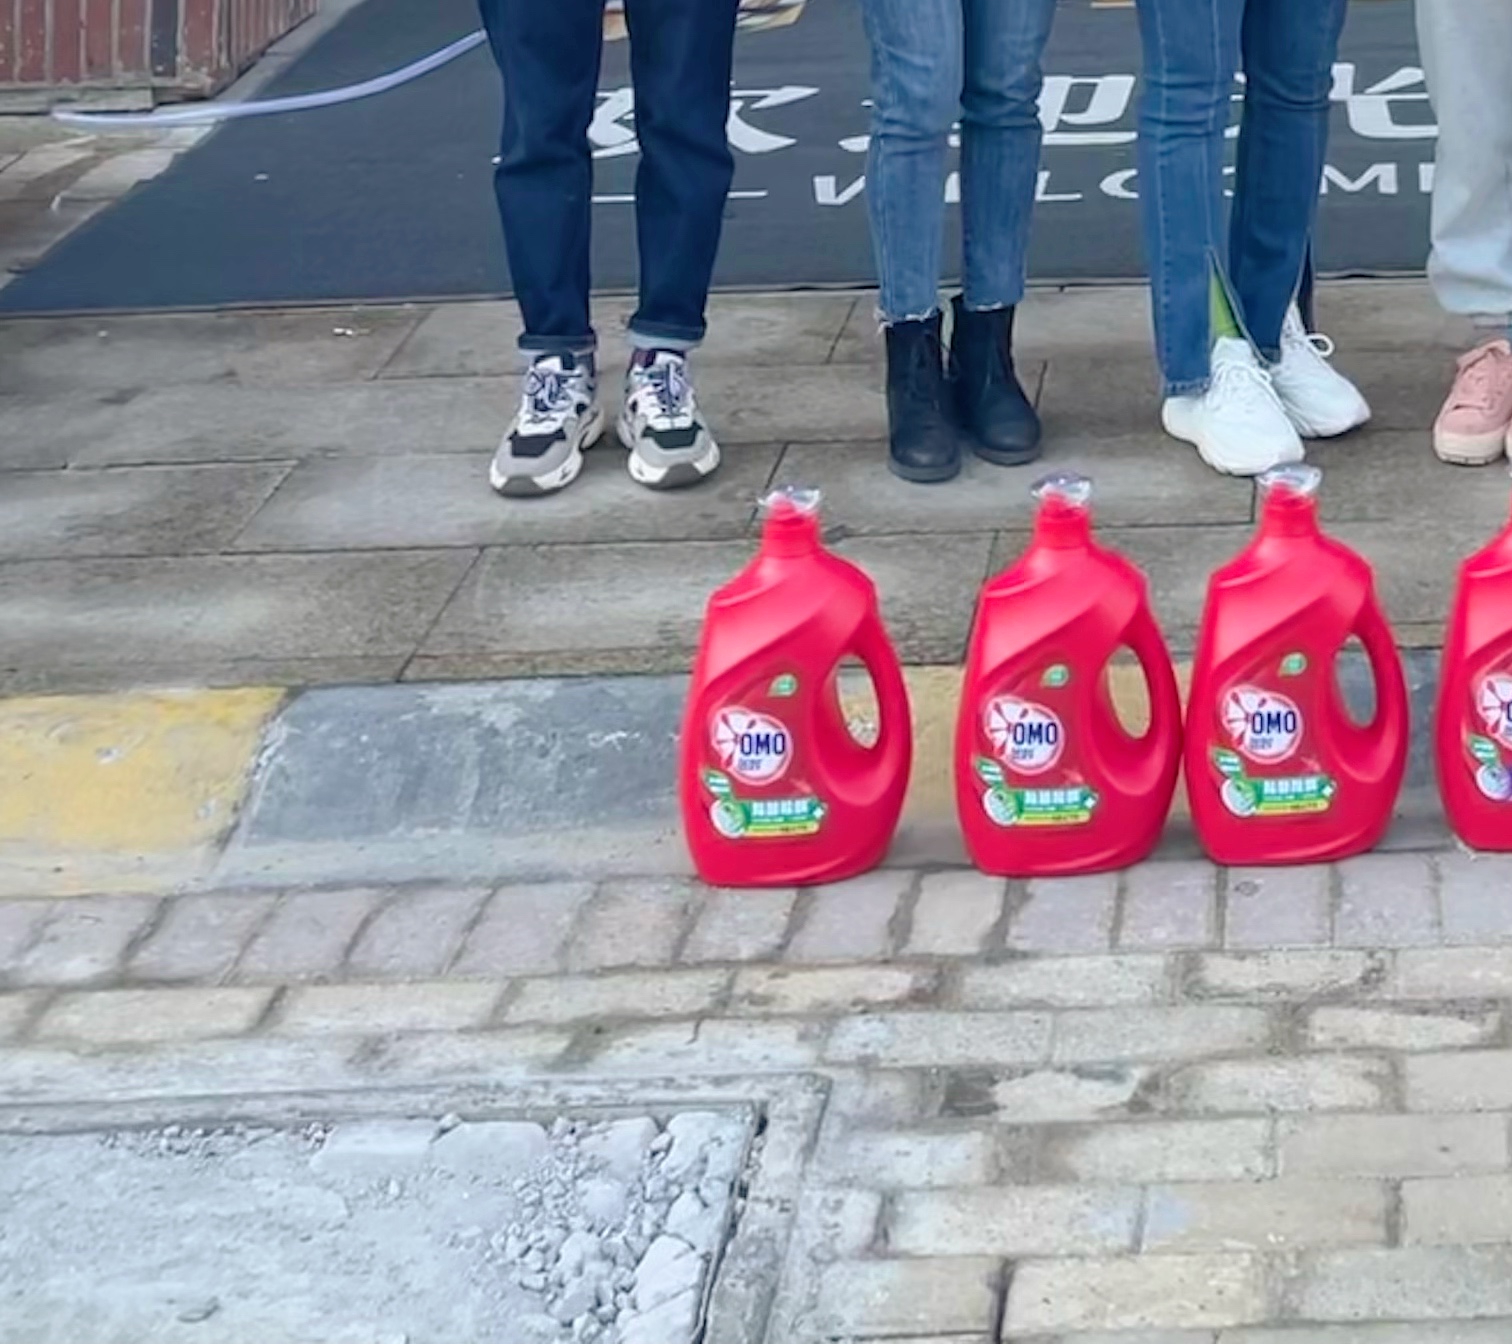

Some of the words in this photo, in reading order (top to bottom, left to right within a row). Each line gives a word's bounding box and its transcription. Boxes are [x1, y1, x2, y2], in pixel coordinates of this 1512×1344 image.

[1013, 722, 1058, 745] OMO
[1251, 710, 1297, 734] OMO
[740, 732, 787, 756] OMO
